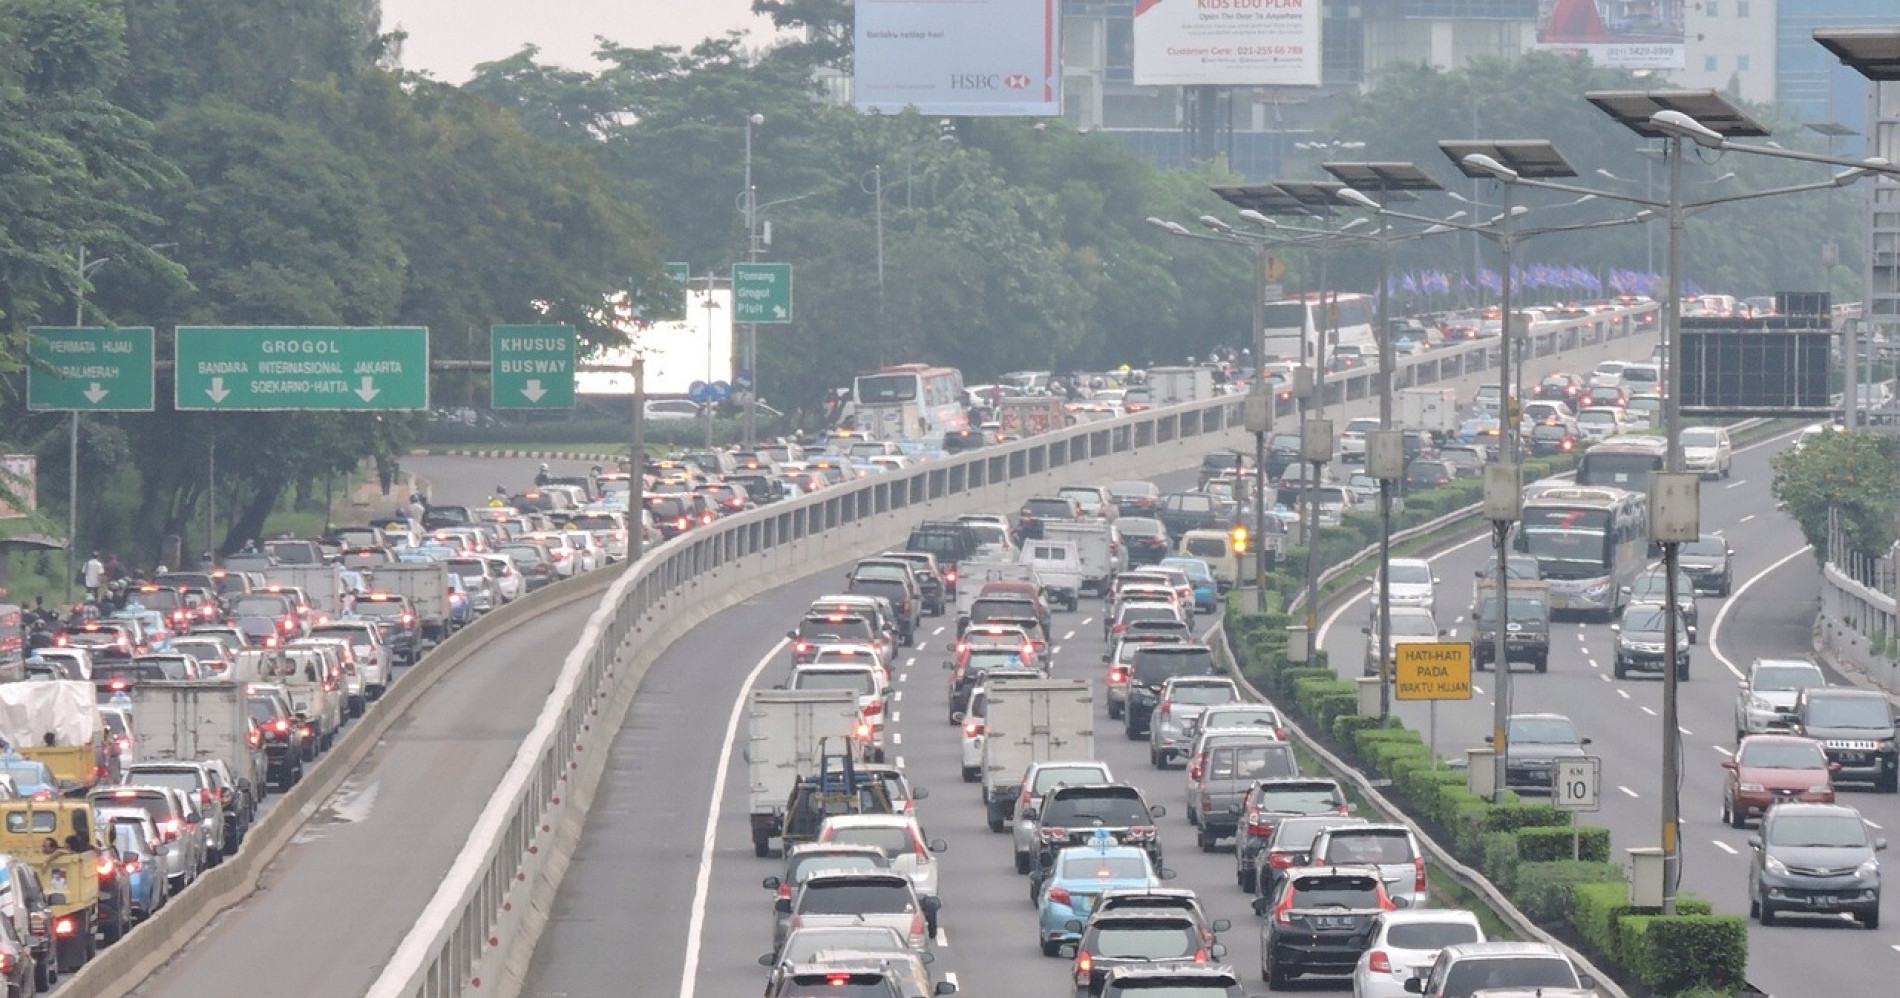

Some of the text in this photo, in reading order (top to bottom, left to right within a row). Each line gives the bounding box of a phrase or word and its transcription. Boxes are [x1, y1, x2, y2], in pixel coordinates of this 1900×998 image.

[951, 74, 999, 89] HSBC
[102, 341, 133, 353] HIJAU
[261, 340, 340, 354] GROGOL
[501, 338, 567, 352] KHUSUS
[198, 361, 403, 374] BANDARA INTERNASIONAL JAKARTA
[501, 359, 567, 373] BUSWAY
[250, 380, 349, 393] SOEKARNO-HATTA
[1405, 650, 1462, 662] HATI-HATI
[1417, 666, 1449, 677] PADA
[1400, 682, 1469, 693] WAKTU HUJAN
[1568, 767, 1585, 777] KM
[1566, 781, 1587, 800] 10
